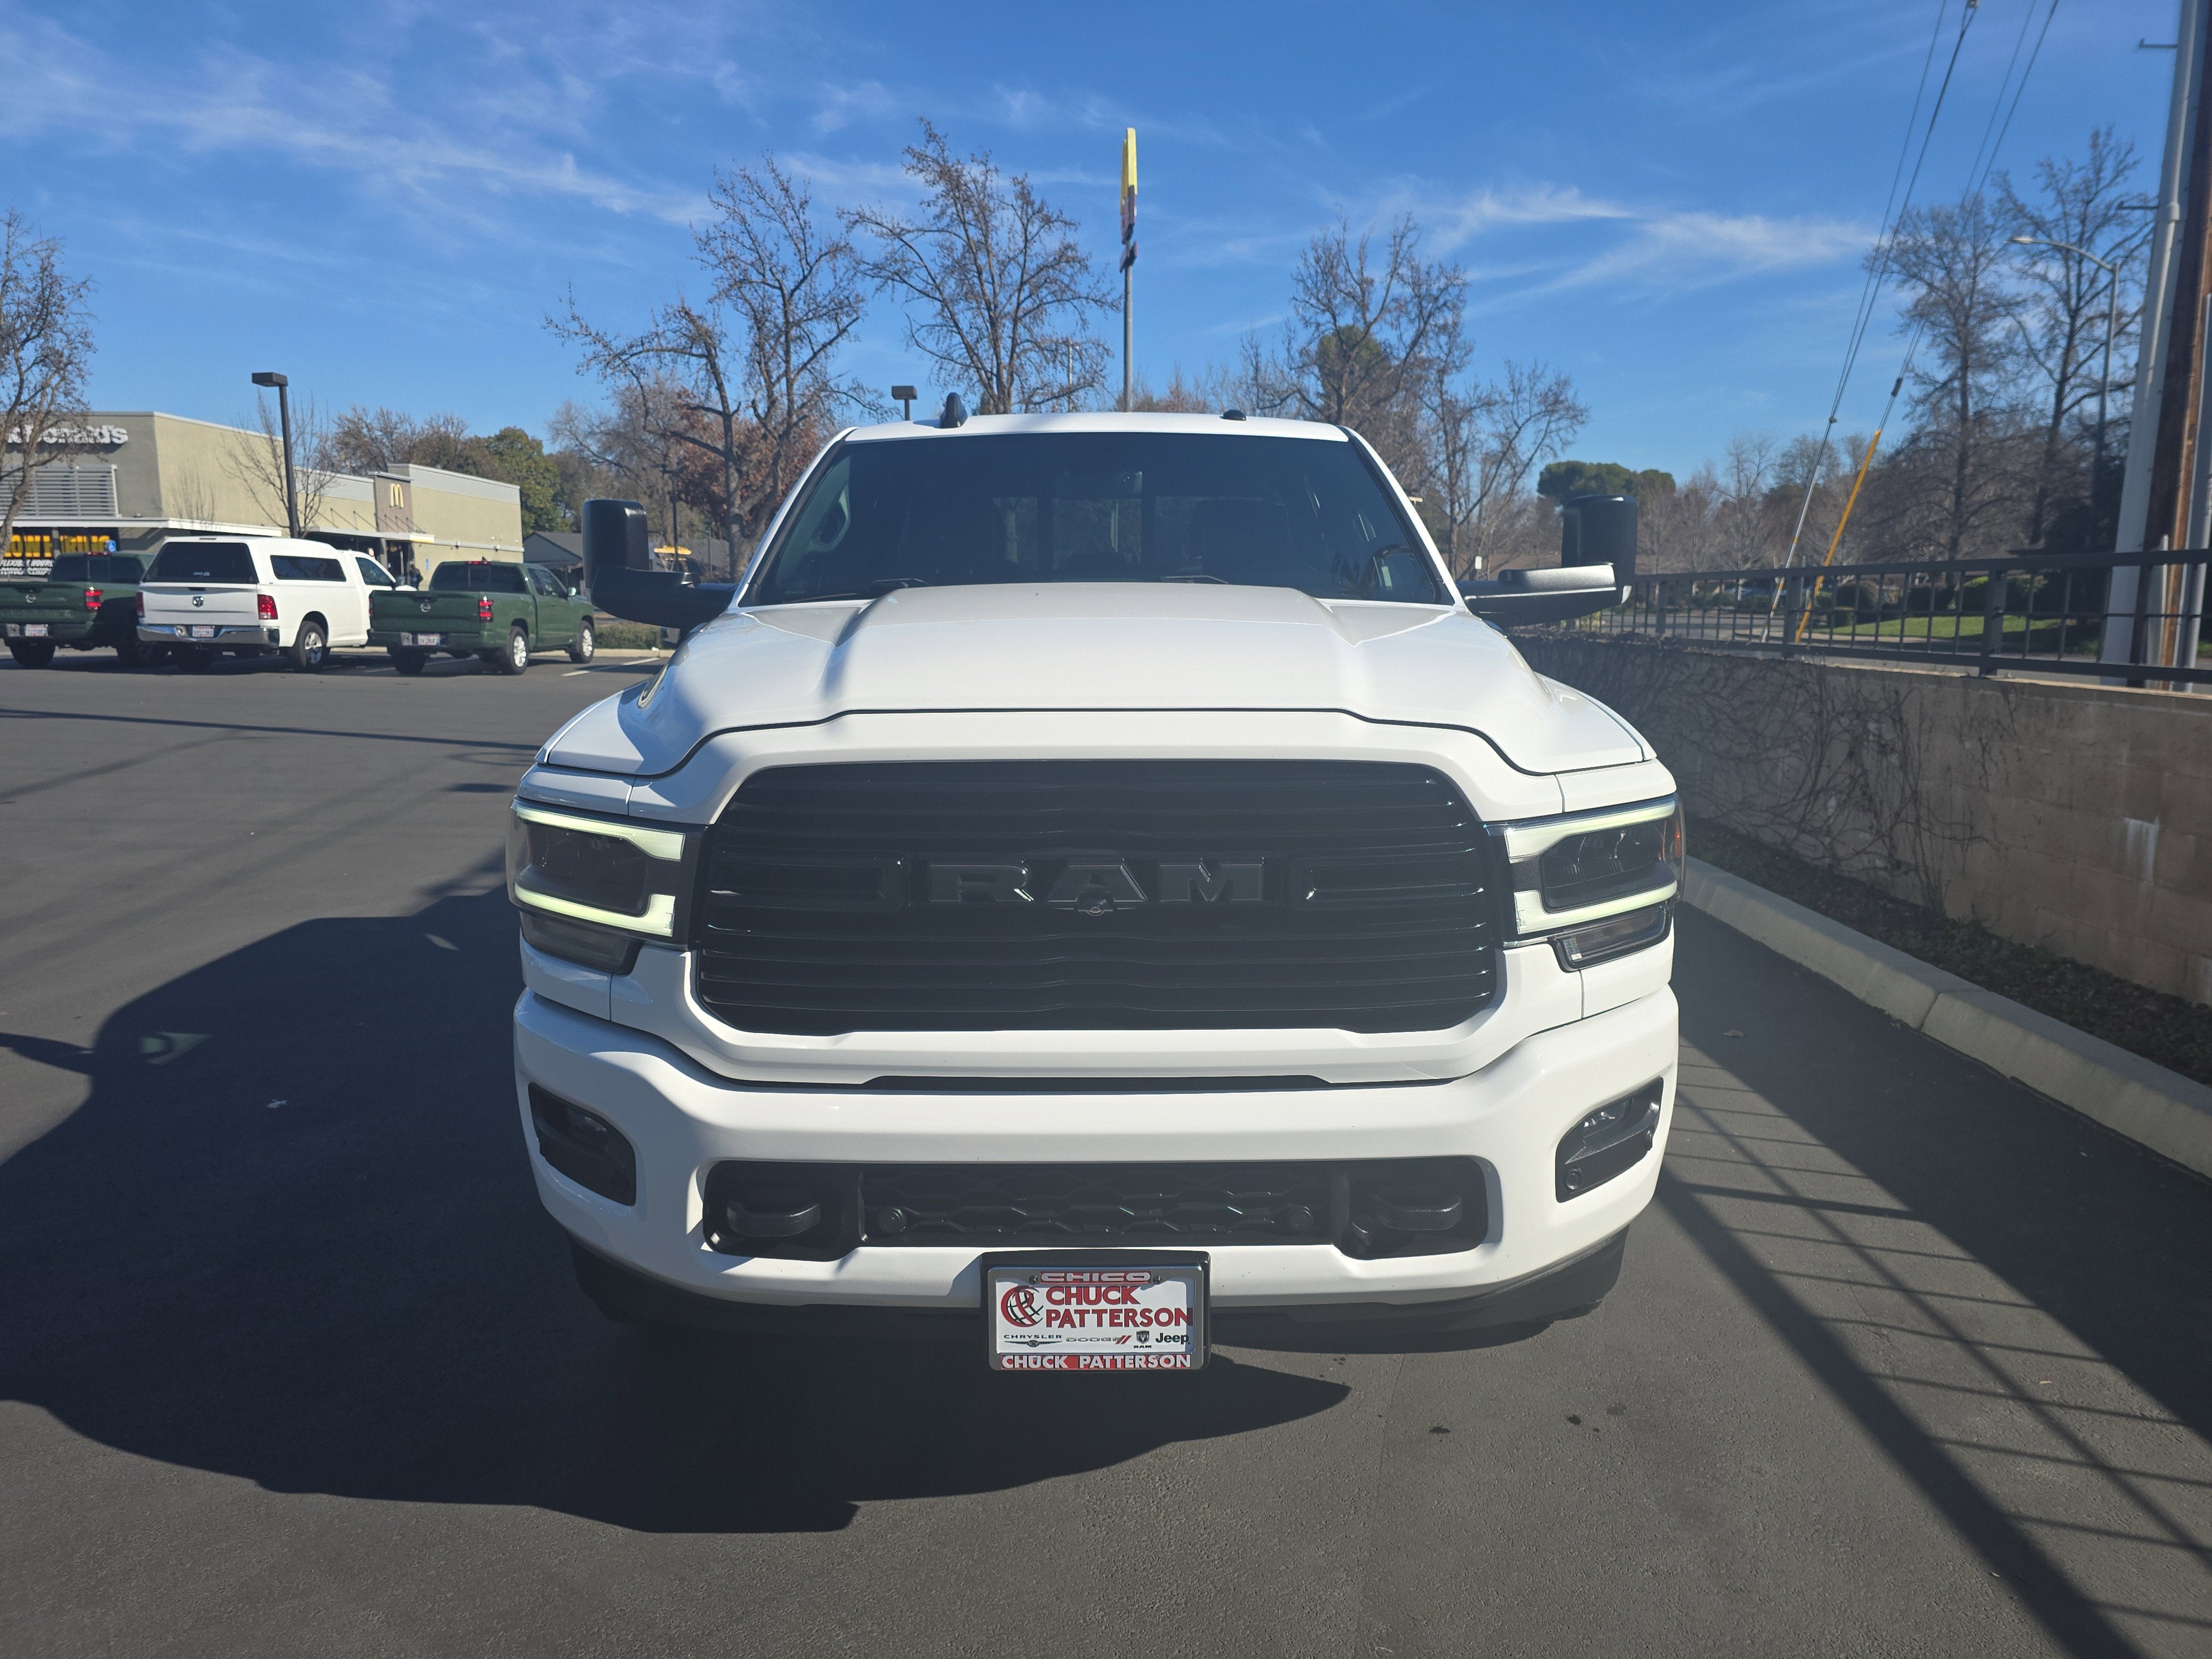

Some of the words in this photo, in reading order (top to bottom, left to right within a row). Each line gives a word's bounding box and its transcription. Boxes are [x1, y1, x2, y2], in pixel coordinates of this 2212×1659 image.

[928, 863, 1263, 902] RAM
[1041, 1272, 1150, 1281] CHICO
[1046, 1286, 1141, 1306] CHUCK
[1046, 1308, 1193, 1328] PATTERSON
[1155, 1333, 1189, 1345] Jeep
[1002, 1355, 1068, 1369] CHUCK
[1079, 1354, 1191, 1369] PATTERSON
